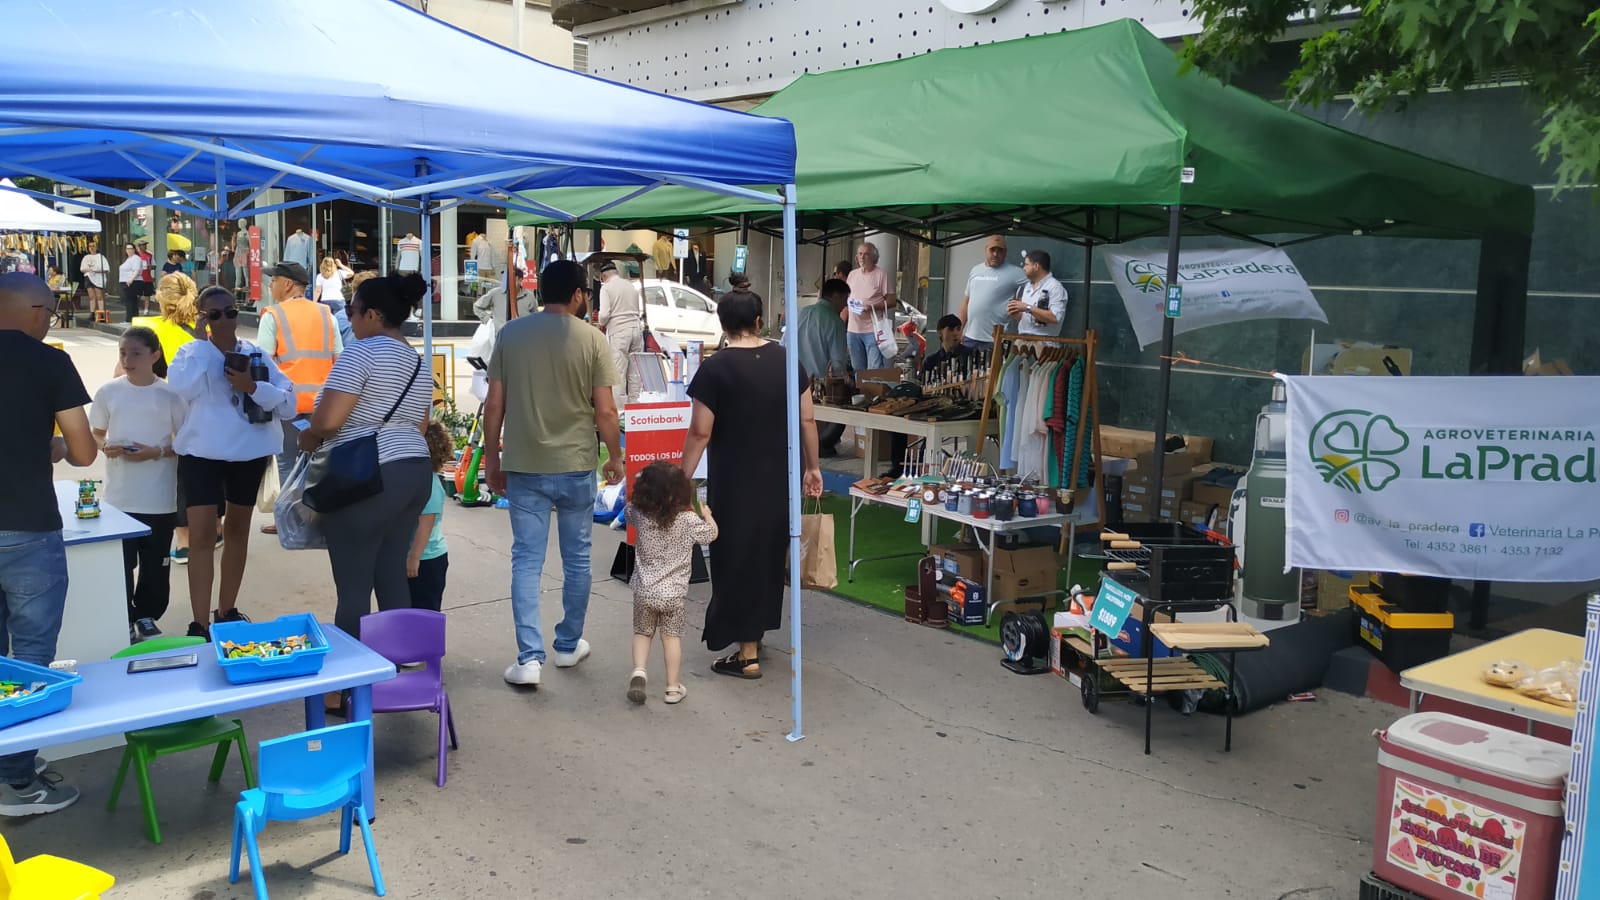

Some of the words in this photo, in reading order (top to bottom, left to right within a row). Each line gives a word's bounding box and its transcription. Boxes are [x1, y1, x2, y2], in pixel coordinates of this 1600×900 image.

[630, 413, 683, 426] Scotiabank
[1423, 428, 1596, 441] AGROVETERINARIA
[629, 453, 656, 462] TODOS
[1421, 444, 1600, 483] LaPrad
[1488, 523, 1562, 539] Veterinaria
[1567, 527, 1584, 539] La
[1426, 541, 1457, 553] 4352
[1460, 543, 1488, 554] 3861
[1500, 545, 1531, 556] 4353
